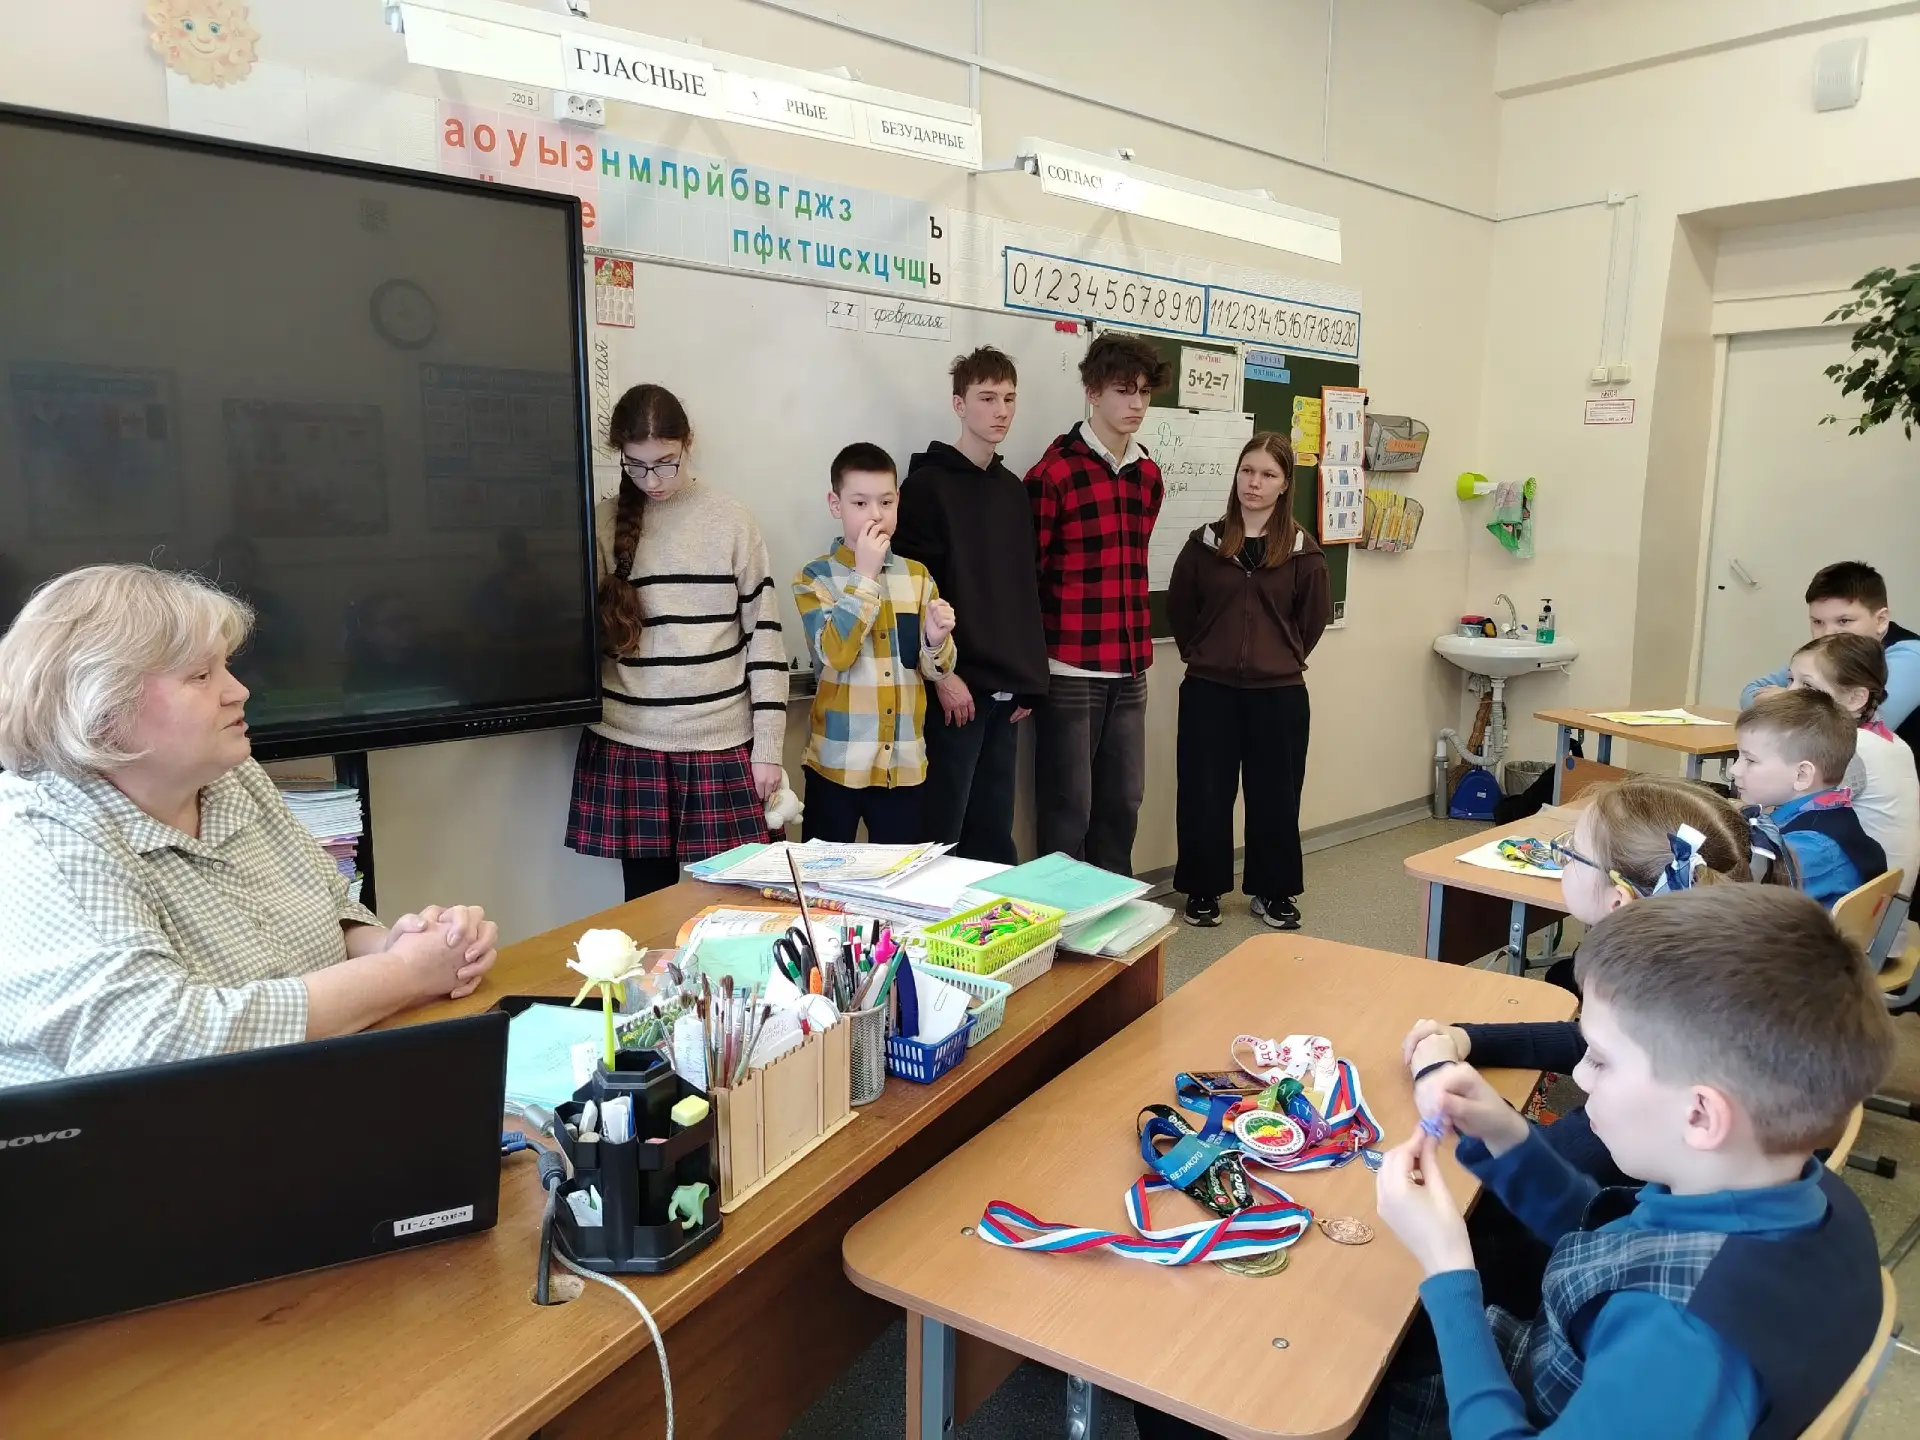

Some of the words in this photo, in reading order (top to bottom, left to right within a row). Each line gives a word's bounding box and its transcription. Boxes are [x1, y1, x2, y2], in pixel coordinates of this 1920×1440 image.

[573, 47, 707, 97] ГЛАСНЫЕ
[512, 92, 526, 104] 220
[881, 119, 966, 150] БЕЗУДАРНЫЕ
[1047, 164, 1123, 192] СОГЛАС
[1013, 262, 1027, 295] 0
[1034, 266, 1044, 297] 1
[1046, 268, 1063, 301] 2
[1067, 272, 1082, 304] 3
[1086, 275, 1099, 307] 4
[1104, 278, 1119, 310] 5
[1122, 283, 1136, 313] 6
[1140, 285, 1151, 316] 7
[1154, 288, 1167, 319] 8
[1169, 291, 1182, 321] 9
[1184, 294, 1202, 324] 10
[873, 301, 944, 334] февраля
[1210, 298, 1224, 327] 11
[1225, 301, 1241, 330] 12
[1241, 303, 1256, 332] 13
[1257, 306, 1272, 334] 14
[1273, 308, 1287, 336] 15
[1288, 311, 1301, 339] 16
[1303, 314, 1317, 341] 17
[1317, 317, 1330, 343] 18
[1329, 319, 1343, 345] 19
[1342, 320, 1356, 347] 20
[1188, 367, 1230, 391] 5+2=7
[1169, 1150, 1204, 1182] ВЕЛИКОГО
